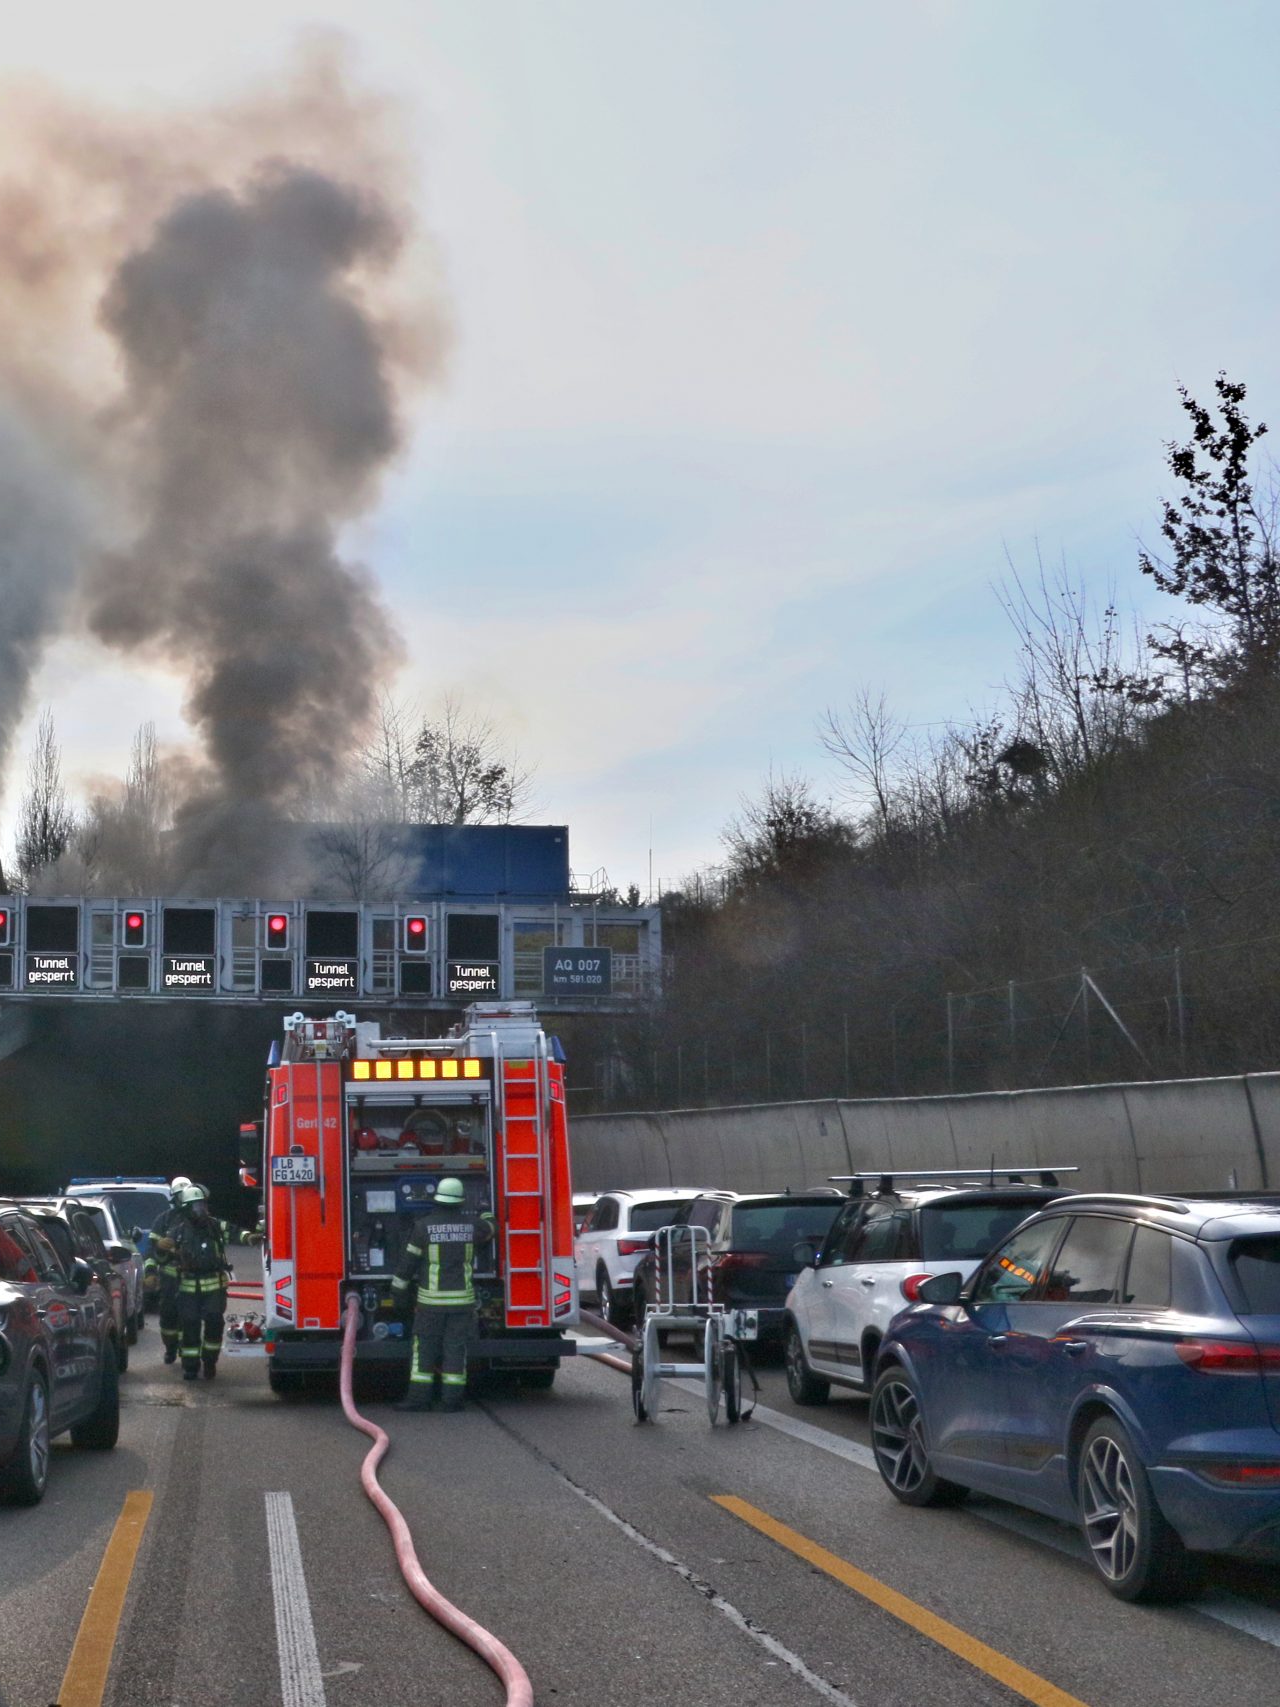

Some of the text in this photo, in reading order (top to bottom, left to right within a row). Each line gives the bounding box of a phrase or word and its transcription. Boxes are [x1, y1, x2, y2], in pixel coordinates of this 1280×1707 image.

[34, 957, 69, 969] Tunnel
[170, 960, 206, 972] Tunnel
[314, 963, 349, 975] Tunnel
[555, 960, 600, 972] AQ 007
[28, 970, 75, 983] gesperrt
[455, 965, 490, 978] Tunnel
[165, 972, 211, 986] gesperrt
[308, 975, 354, 989] gesperrt
[450, 978, 496, 992] gesperrt
[553, 975, 567, 983] km
[281, 1159, 293, 1169] LB
[275, 1170, 313, 1180] FG 1420
